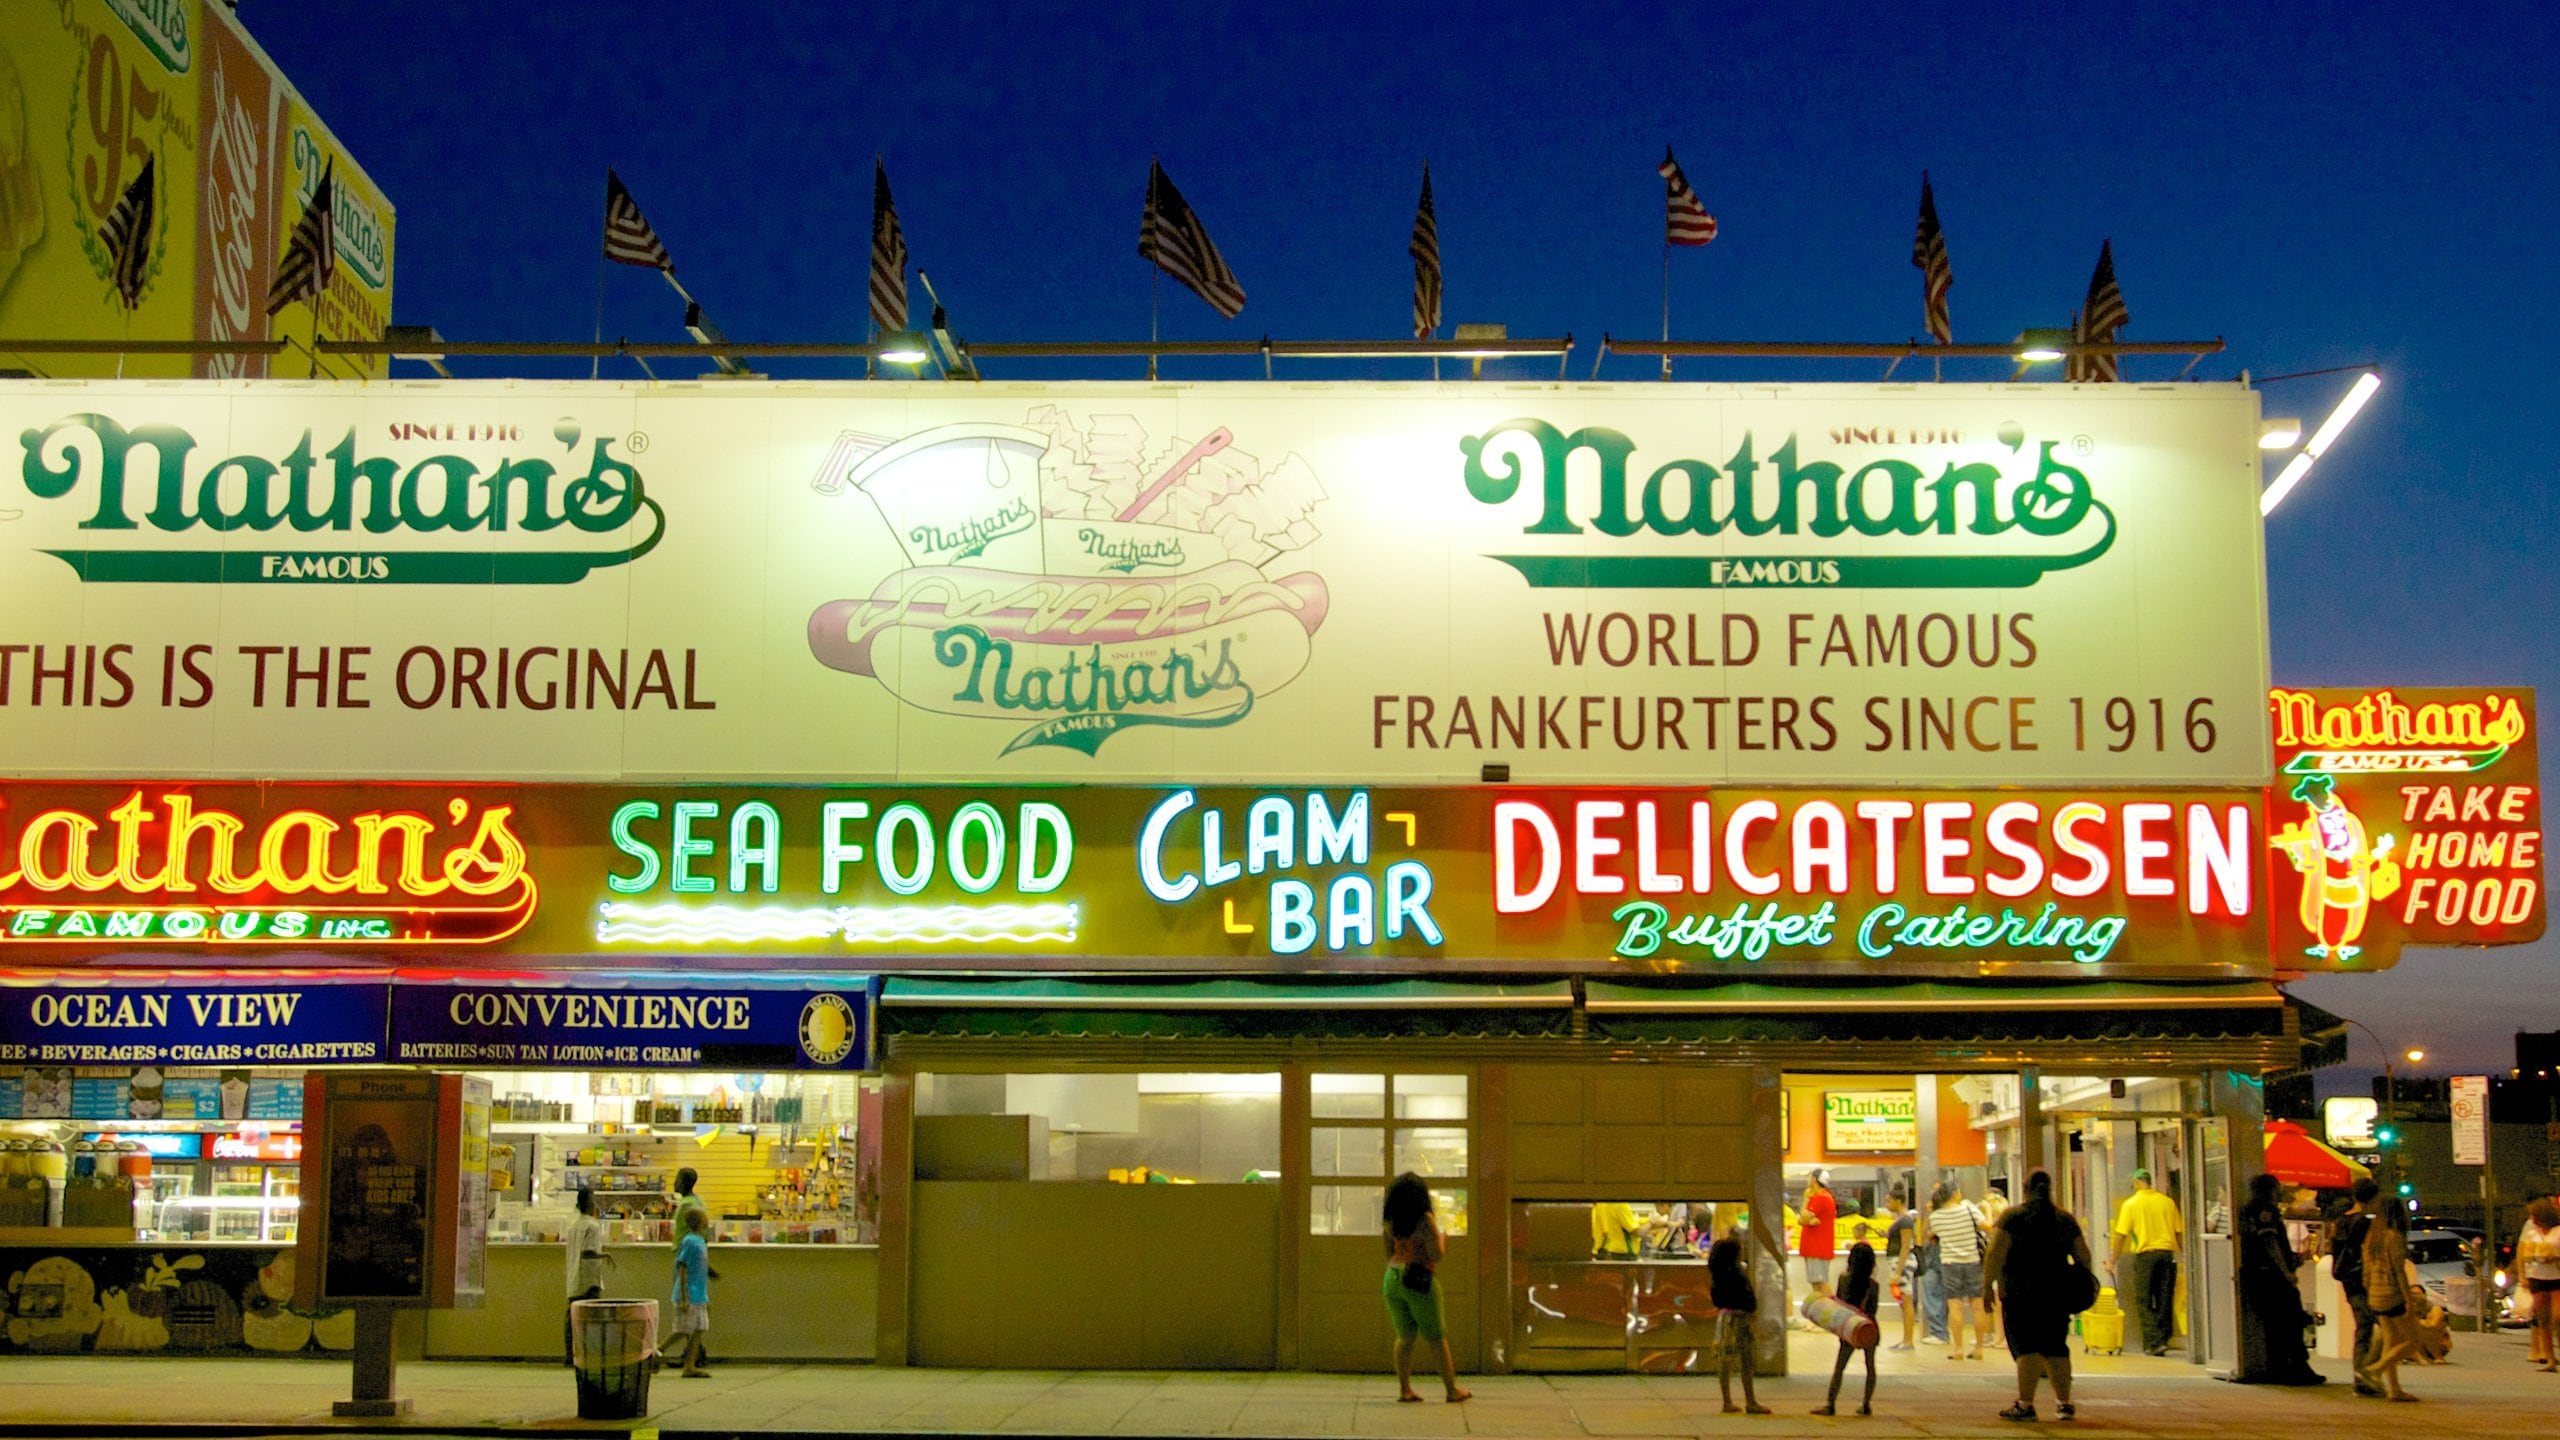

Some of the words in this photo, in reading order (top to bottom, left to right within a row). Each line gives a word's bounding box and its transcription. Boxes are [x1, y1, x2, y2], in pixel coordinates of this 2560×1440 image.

[294, 129, 386, 272] Nthan's
[389, 423, 460, 442] SINCE
[468, 423, 525, 442] 1916
[1829, 427, 1900, 444] SINCE
[1909, 427, 1966, 444] 1916
[20, 412, 645, 533] Nathan's
[1459, 417, 2093, 536] Nathan's
[909, 496, 1028, 554] Nathan's
[1079, 528, 1182, 559] Nathan's
[262, 556, 390, 579] FAMOUS
[1710, 560, 1840, 585] FAMOUS
[1543, 613, 1760, 668] WORLD
[1788, 613, 2038, 668] FAMOUS
[0, 645, 134, 708] THIS
[161, 644, 214, 709] IS
[239, 647, 371, 709] THE
[396, 646, 716, 710] ORIGINAL
[931, 624, 1240, 712] Nathan's
[1043, 715, 1116, 738] FAMOUS
[1373, 696, 1838, 752] FRANKFURTERS
[1864, 696, 2038, 752] SINCE
[2069, 696, 2217, 753] 1916
[2269, 690, 2526, 746] Nathan's
[2401, 786, 2532, 822] TAKE
[0, 790, 526, 895] athan's
[608, 800, 780, 894] SEA
[822, 800, 1073, 894] FOOD
[1138, 789, 1369, 902] CLAM
[1492, 800, 2250, 916] DELICATESSEN
[2405, 832, 2540, 869] HOME
[1269, 860, 1444, 954] BAR
[2403, 878, 2537, 925] FOOD
[11, 910, 311, 938] FAMOUS
[1612, 900, 1836, 960] Buffet
[1857, 902, 2128, 963] Catering
[31, 994, 171, 1027] OCEAN
[186, 993, 302, 1027] VIEW
[449, 992, 750, 1030] CONVENIENCE
[809, 997, 846, 1011] ISLAND
[0, 1044, 27, 1060] EE
[41, 1044, 157, 1060] BEVERAGES
[170, 1044, 241, 1060] CIGARS
[255, 1042, 376, 1060] CIGARETTES
[400, 1043, 478, 1060] BATTERIES
[487, 1044, 515, 1060] SUN
[521, 1044, 548, 1060] TAN
[553, 1045, 603, 1061] LOTION
[614, 1046, 638, 1061] ICE
[642, 1046, 693, 1063] CREAM
[804, 1040, 836, 1062] COFFEE
[360, 1081, 406, 1093] Phone
[199, 1101, 215, 1113] $2
